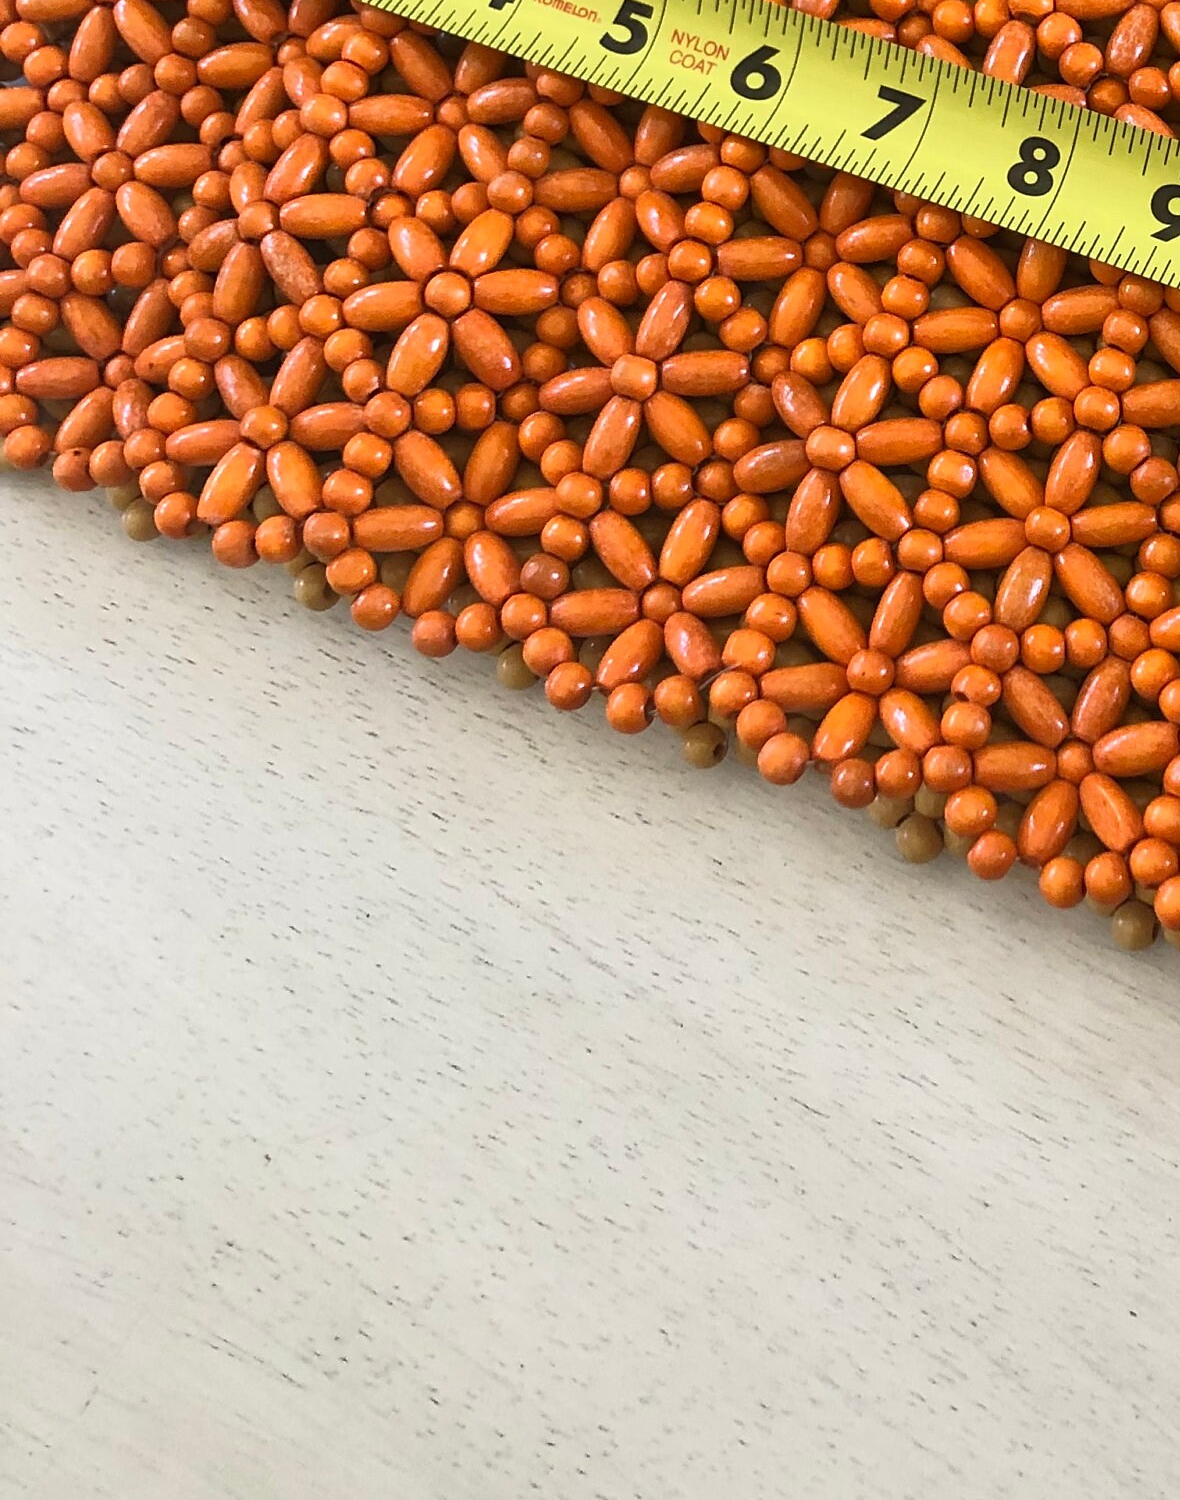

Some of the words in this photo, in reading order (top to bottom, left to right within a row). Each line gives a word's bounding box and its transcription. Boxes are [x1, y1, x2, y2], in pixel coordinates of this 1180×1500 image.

[669, 50, 718, 76] COAT
[671, 29, 730, 61] NYLON
[730, 45, 781, 100] 6
[861, 85, 927, 140] 7
[1007, 137, 1061, 196] 8
